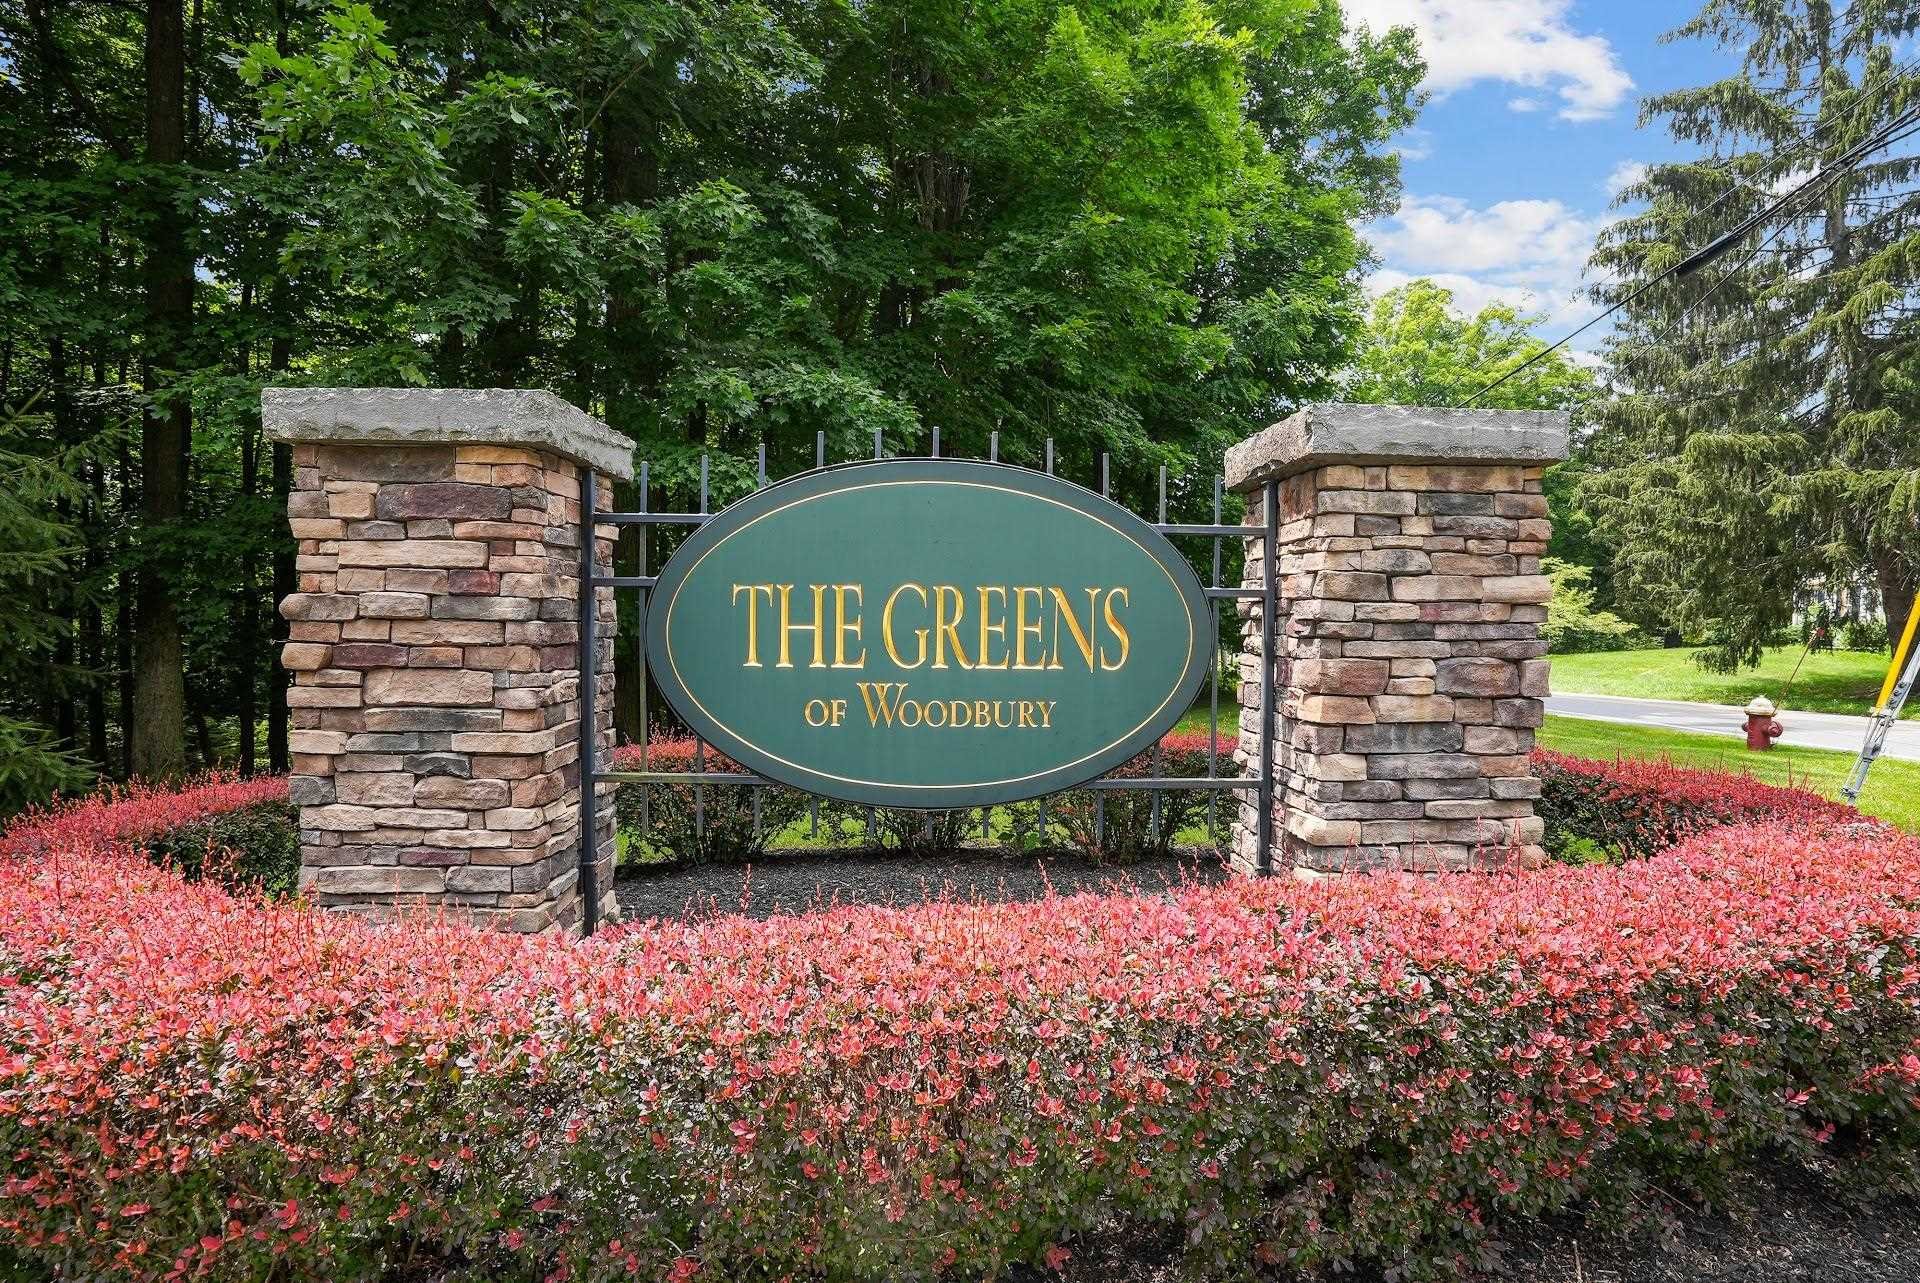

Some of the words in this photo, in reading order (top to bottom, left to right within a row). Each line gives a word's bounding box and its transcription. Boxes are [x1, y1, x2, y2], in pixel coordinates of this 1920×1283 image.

[731, 583, 867, 669] THE
[881, 583, 1131, 673] GREENS
[804, 699, 847, 728] OF
[857, 682, 1057, 729] WOODBURY
